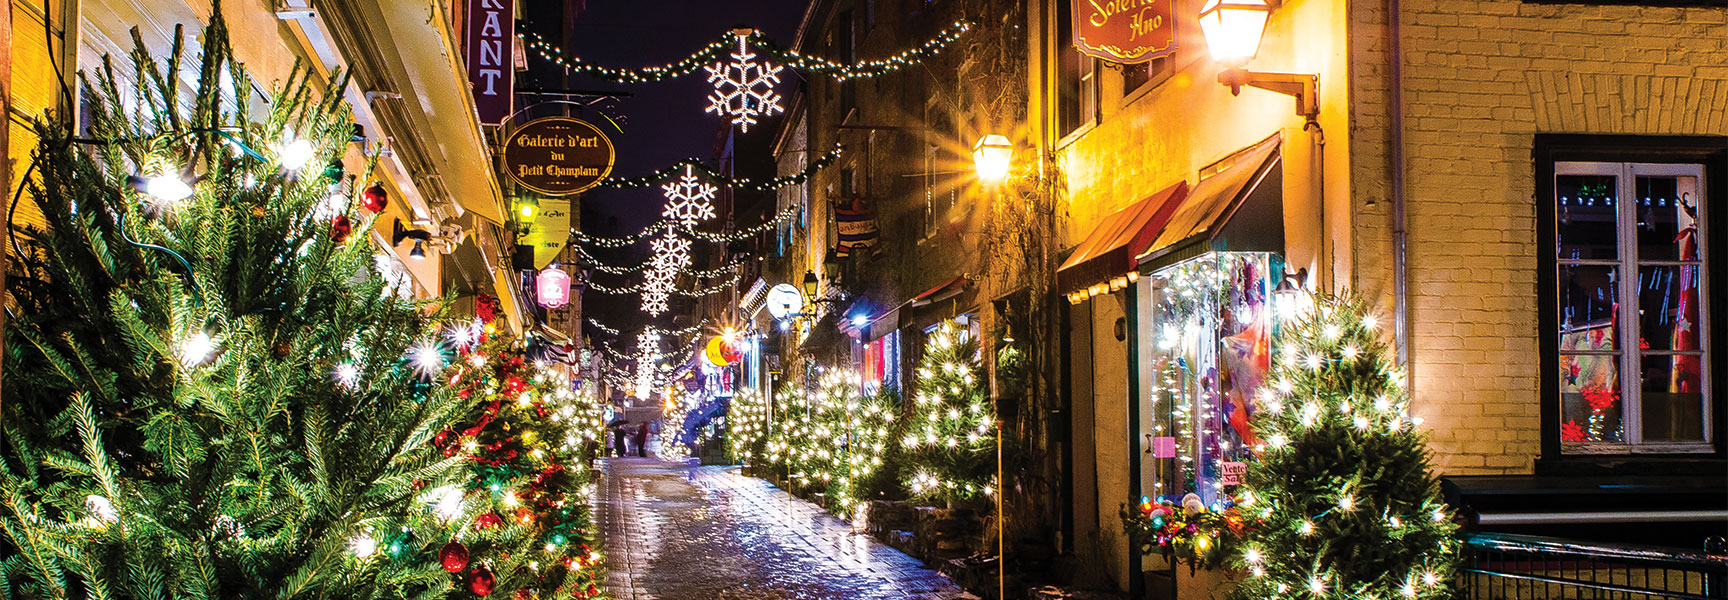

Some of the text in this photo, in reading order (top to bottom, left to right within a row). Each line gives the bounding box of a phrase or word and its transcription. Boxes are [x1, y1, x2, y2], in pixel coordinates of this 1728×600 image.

[1129, 6, 1162, 42] Hno
[517, 133, 598, 148] Galerie d'art
[550, 150, 565, 161] du
[518, 164, 599, 178] Petit Champlain
